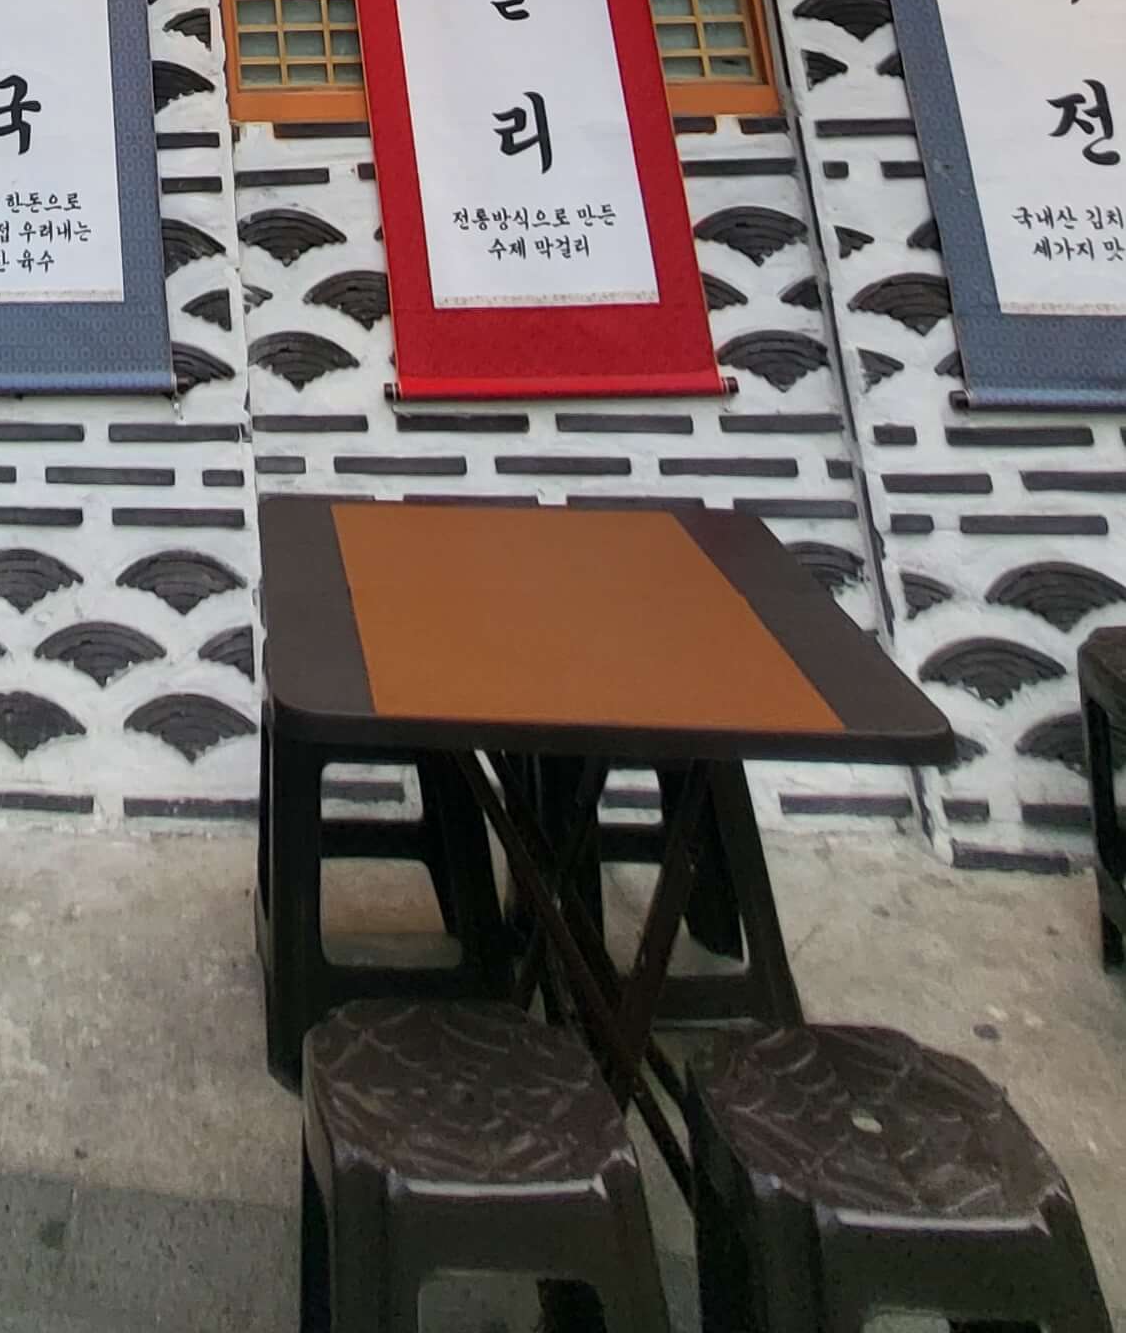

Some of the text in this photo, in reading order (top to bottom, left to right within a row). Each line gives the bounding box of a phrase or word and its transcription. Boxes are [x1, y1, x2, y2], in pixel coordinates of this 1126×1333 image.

[5, 191, 82, 214] 한돈으로
[577, 204, 616, 227] 만든
[1012, 205, 1124, 230] 국내산 김치
[18, 219, 92, 243] 우려내는
[488, 234, 590, 261] 수제 막걸리
[1033, 236, 1125, 262] 세가지 맛
[17, 249, 55, 273] 육수
